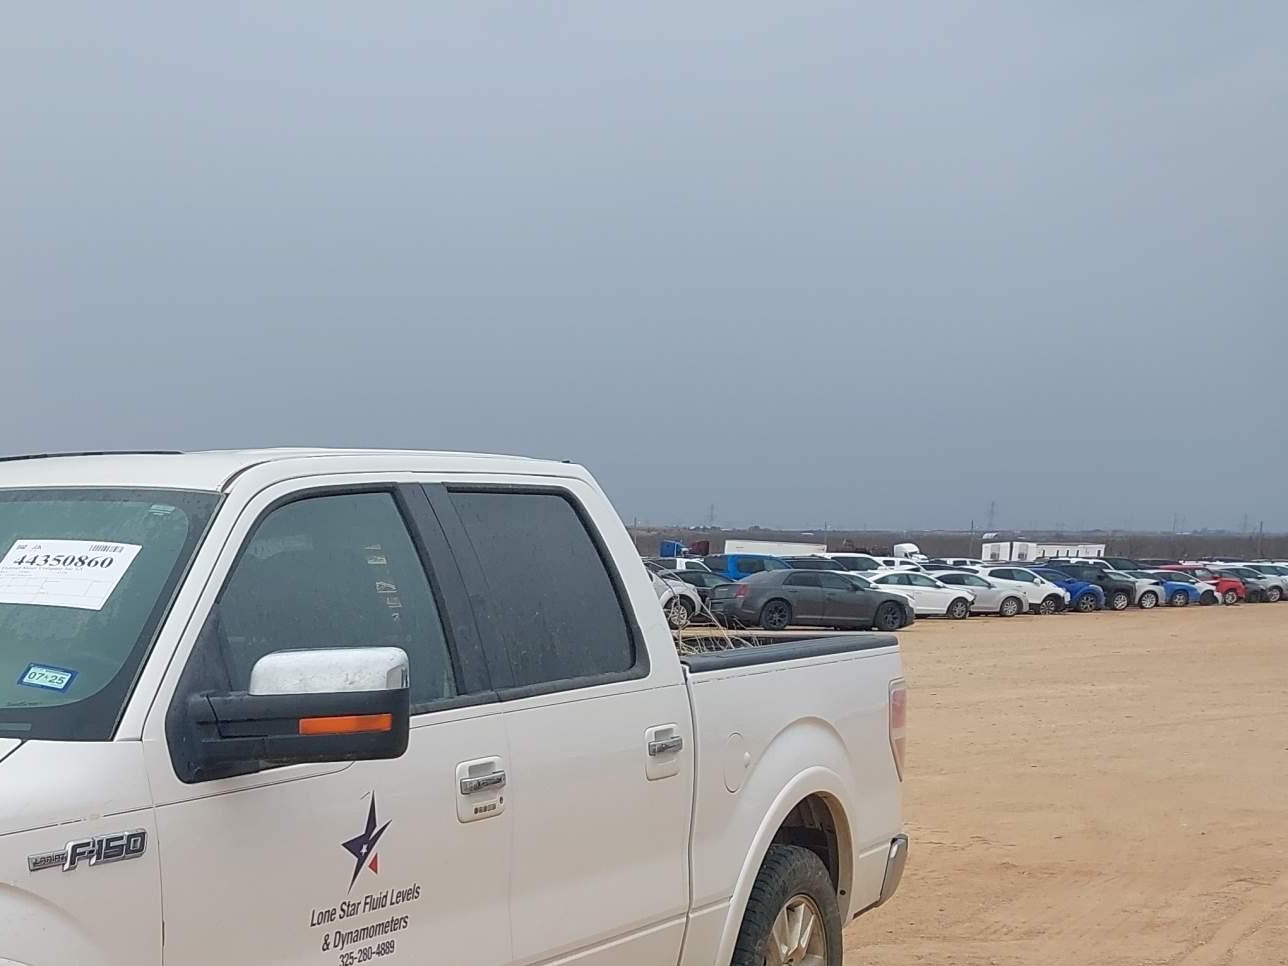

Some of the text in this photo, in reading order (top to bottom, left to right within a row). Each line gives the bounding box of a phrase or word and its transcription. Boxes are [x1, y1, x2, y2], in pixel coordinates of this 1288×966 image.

[13, 554, 114, 569] 44350860
[27, 671, 66, 684] 07 25
[310, 883, 421, 928] Lone Star Fluid Levels
[321, 915, 409, 952] & Dynamometers
